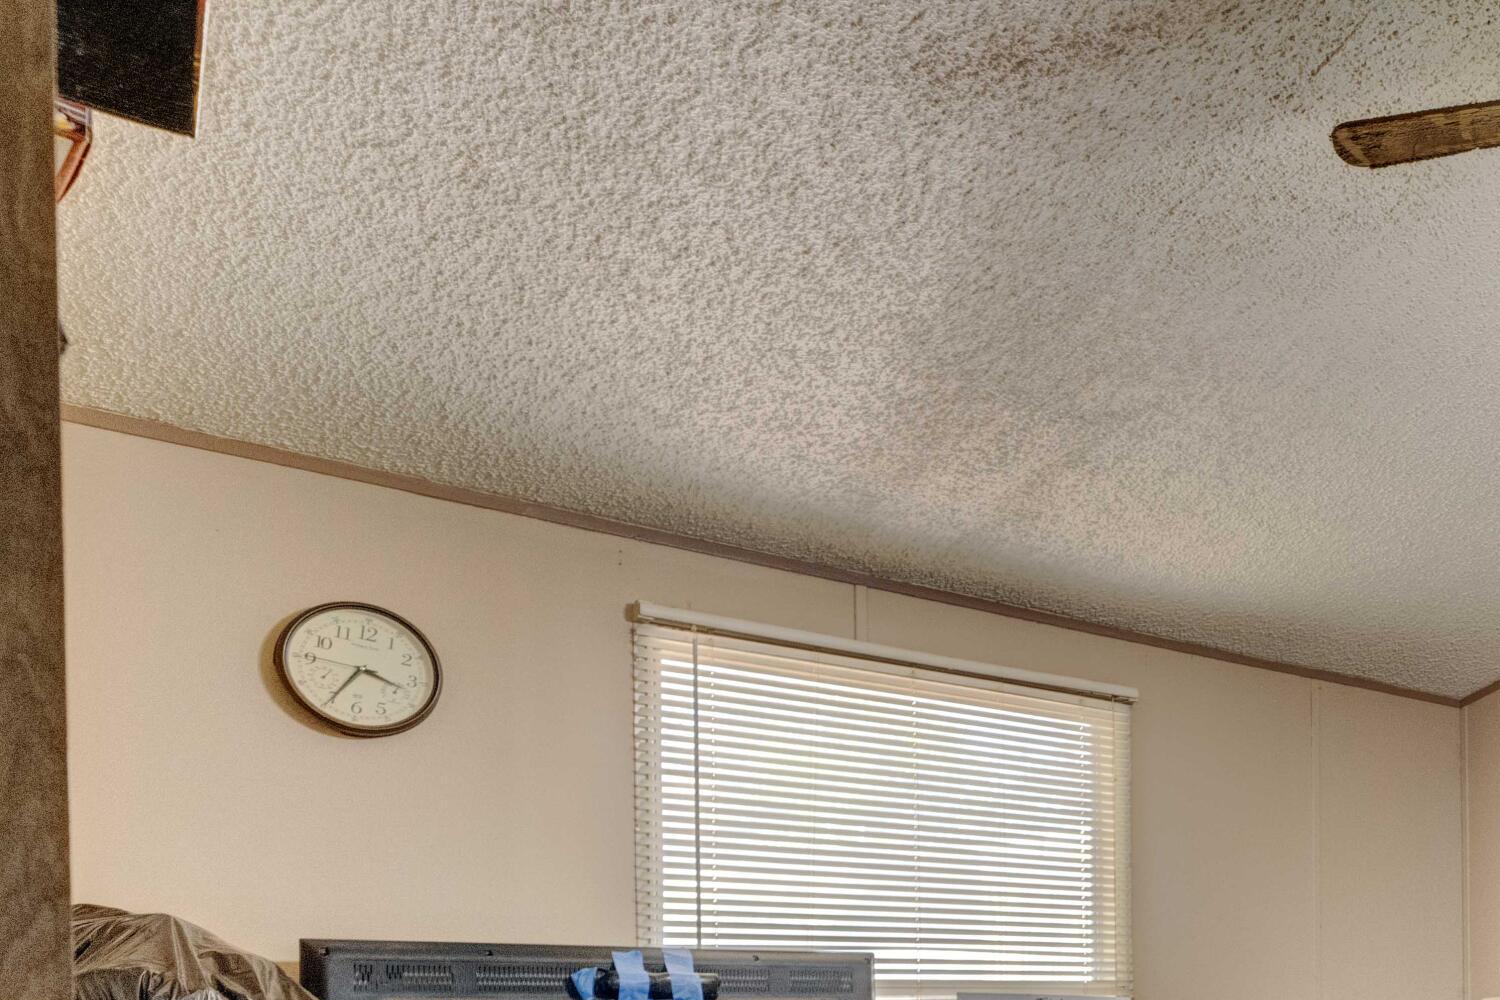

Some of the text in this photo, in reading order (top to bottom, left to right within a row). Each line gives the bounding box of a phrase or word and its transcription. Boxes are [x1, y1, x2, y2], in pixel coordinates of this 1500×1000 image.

[335, 625, 350, 641] 11
[360, 625, 378, 642] 12
[315, 635, 333, 650] 10
[388, 637, 395, 650] 1
[304, 652, 316, 665] 9
[401, 654, 412, 667] 2
[406, 675, 417, 688] 3
[351, 702, 362, 715] 6
[375, 703, 387, 715] 5
